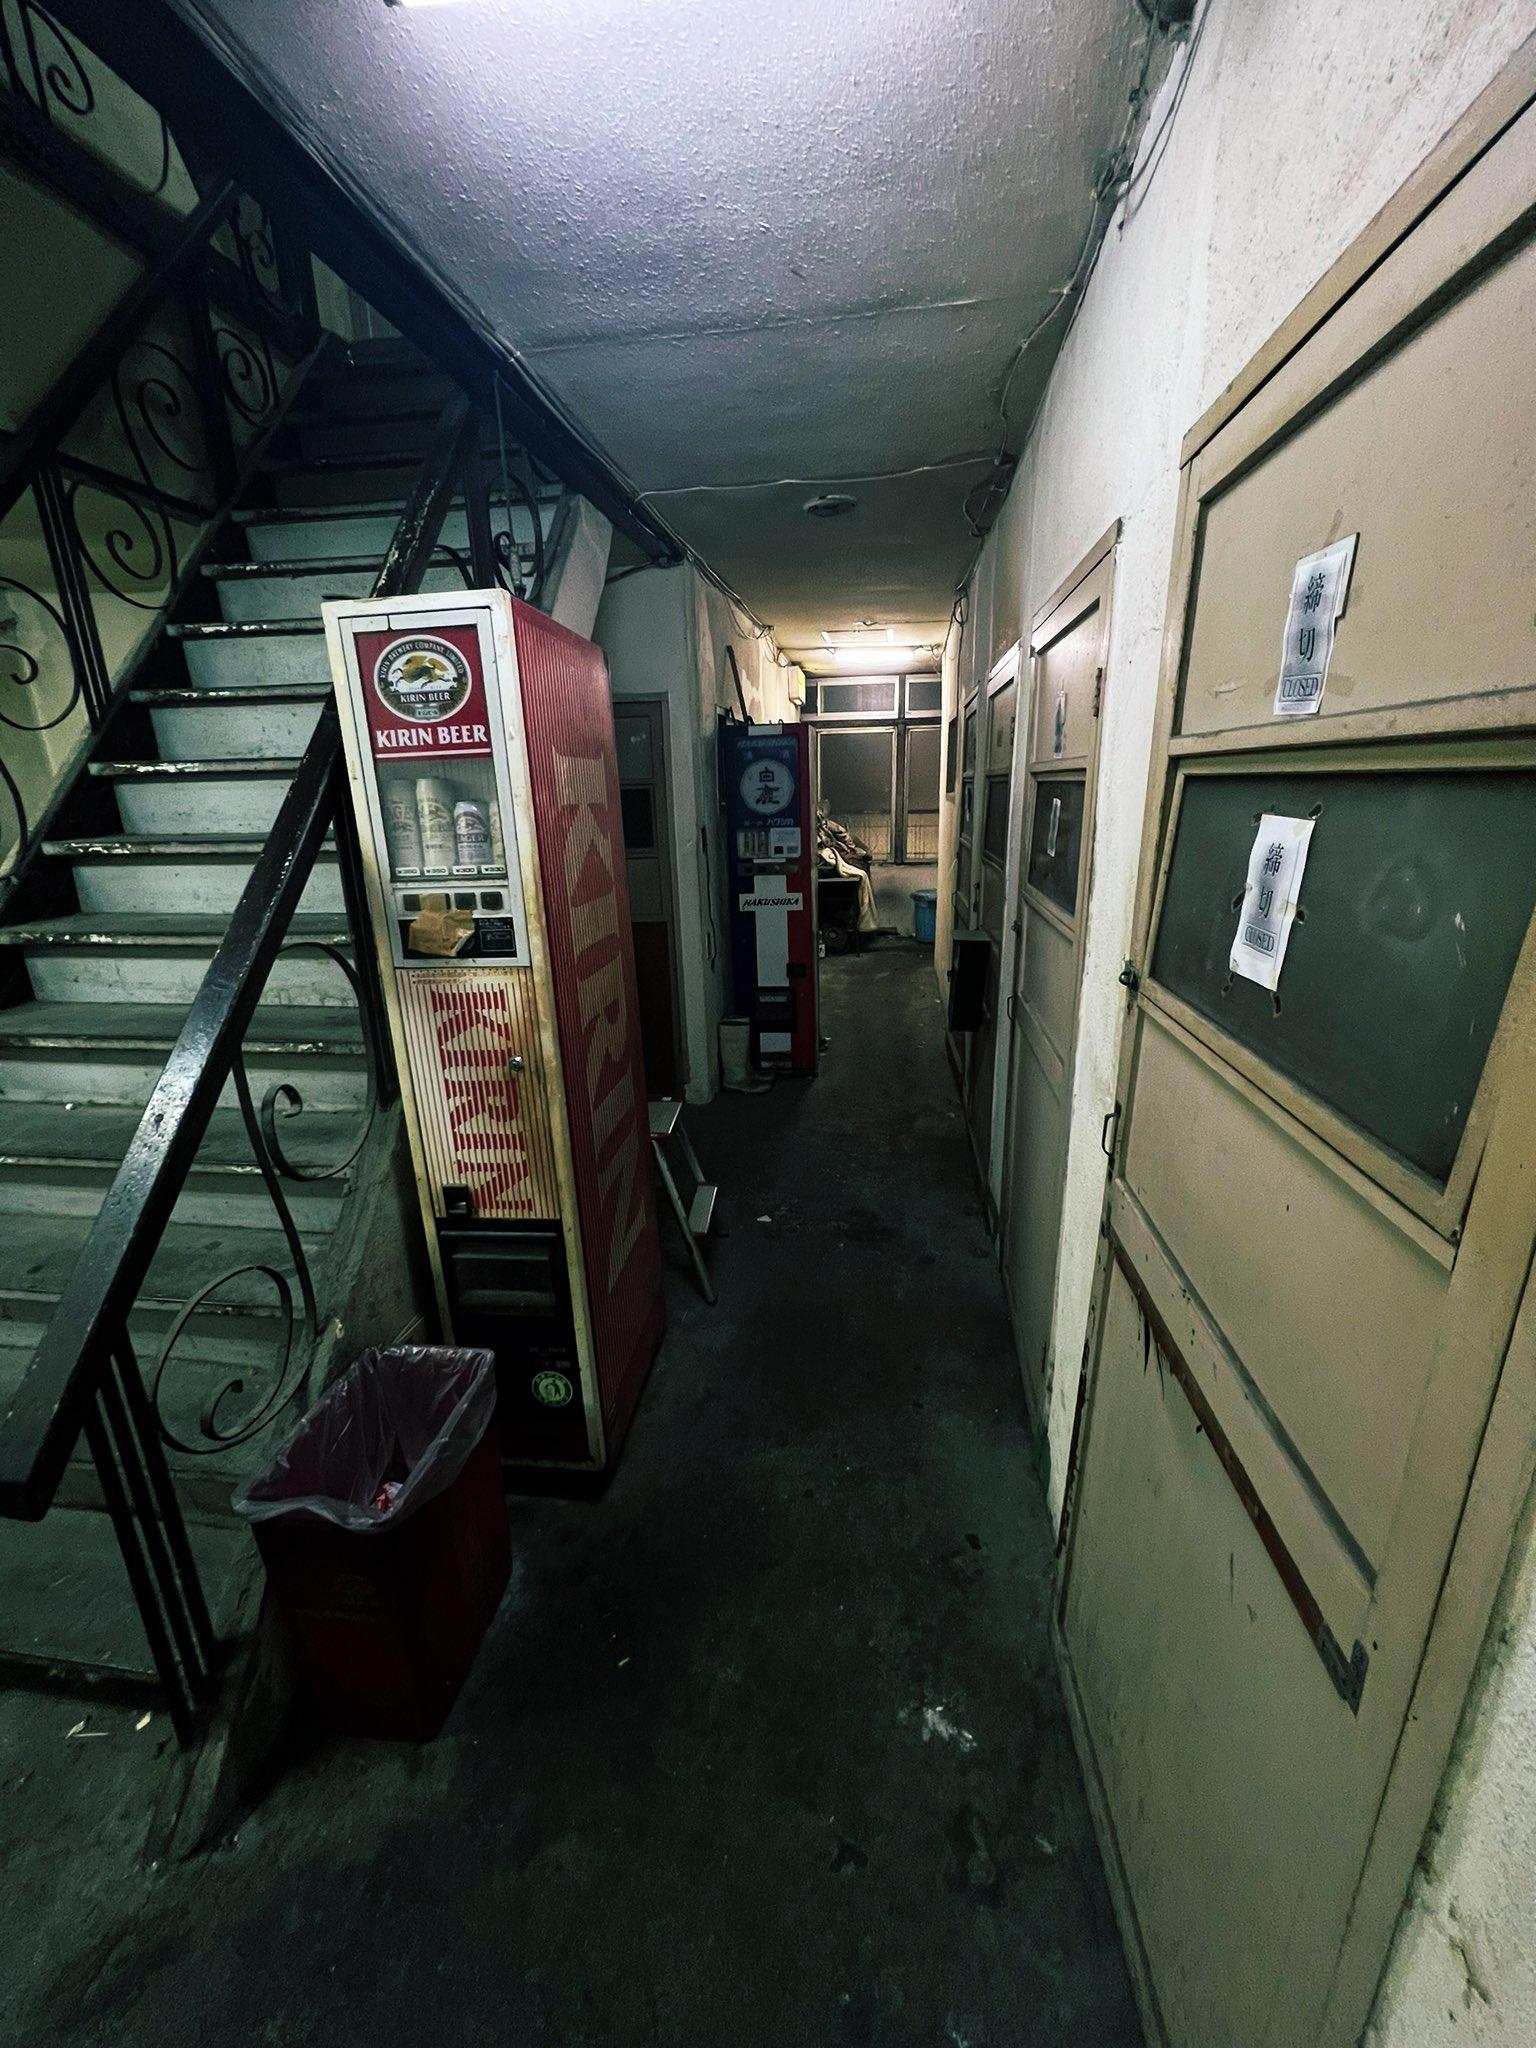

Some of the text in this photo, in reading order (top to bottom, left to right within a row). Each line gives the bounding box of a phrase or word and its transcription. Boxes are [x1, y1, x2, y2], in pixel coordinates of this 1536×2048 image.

[400, 692, 451, 703] KIRIN BEER
[1281, 676, 1319, 699] CLOSED
[375, 724, 488, 748] KIRIN BEER
[743, 898, 800, 908] HAKUSHIKA
[1244, 924, 1275, 953] CLOSED
[550, 743, 648, 1295] KIRIN
[430, 988, 534, 1213] KIRIN
